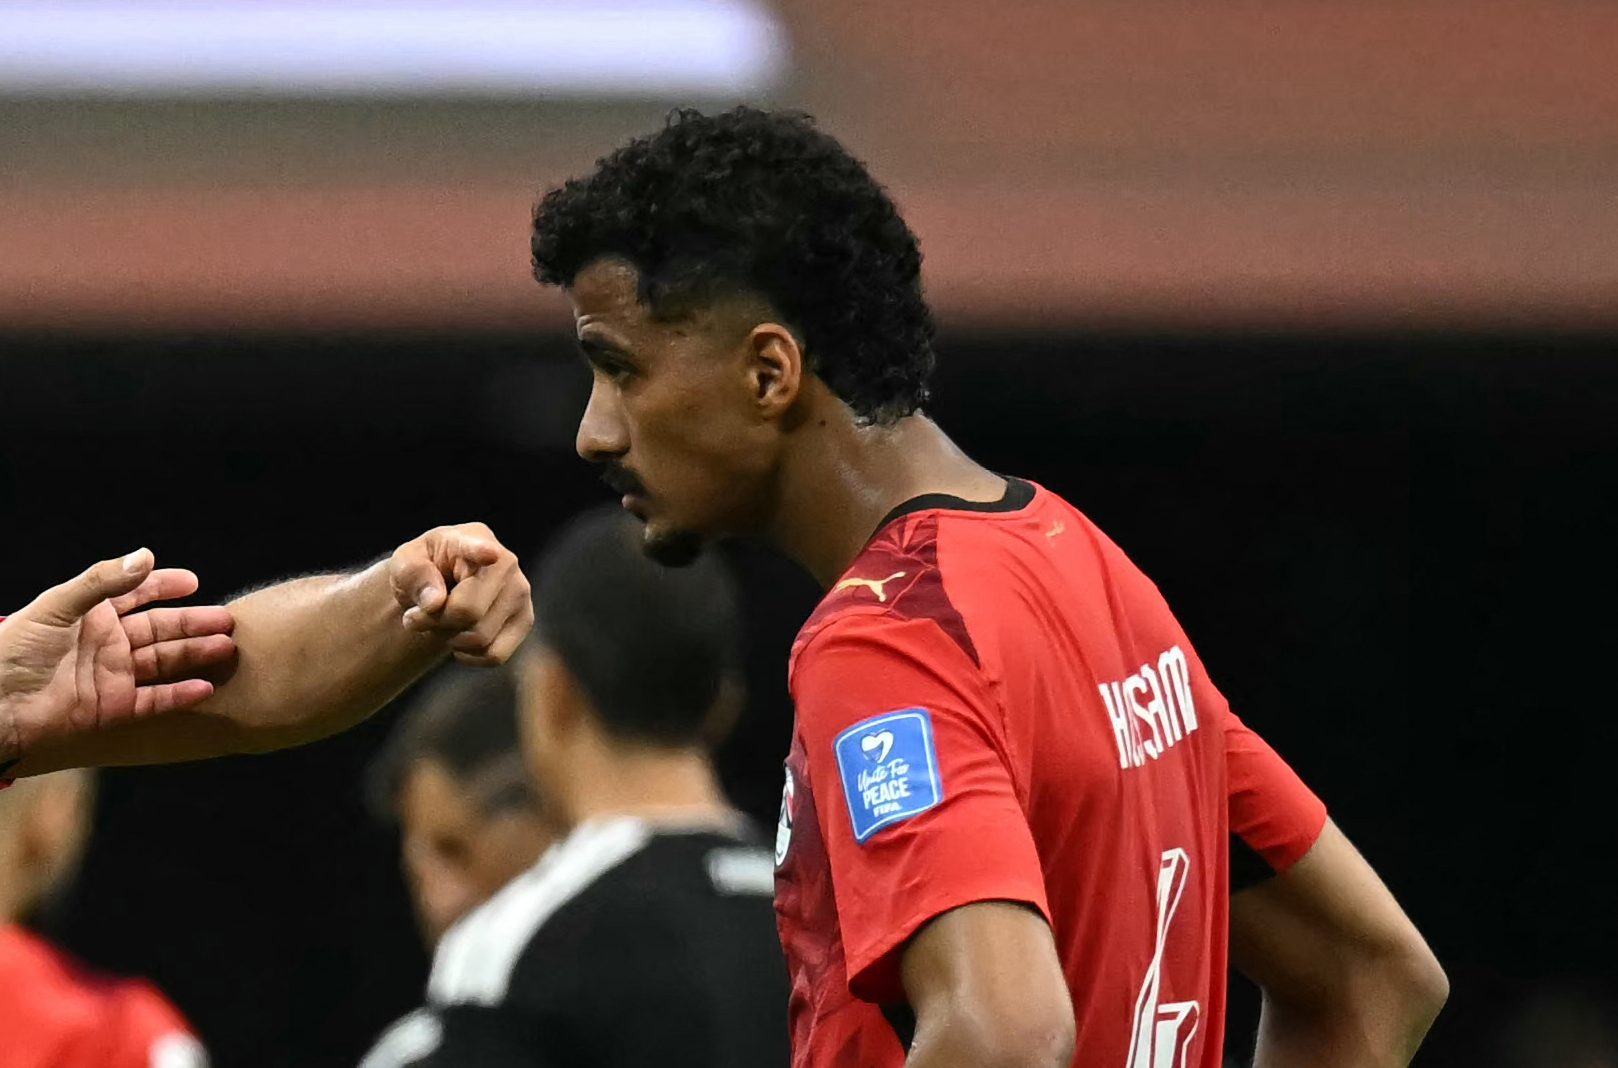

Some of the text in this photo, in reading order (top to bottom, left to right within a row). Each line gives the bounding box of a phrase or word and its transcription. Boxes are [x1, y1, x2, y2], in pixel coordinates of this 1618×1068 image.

[858, 758, 910, 792] Unite For
[863, 777, 911, 810] PEACE
[873, 802, 903, 817] FIFA
